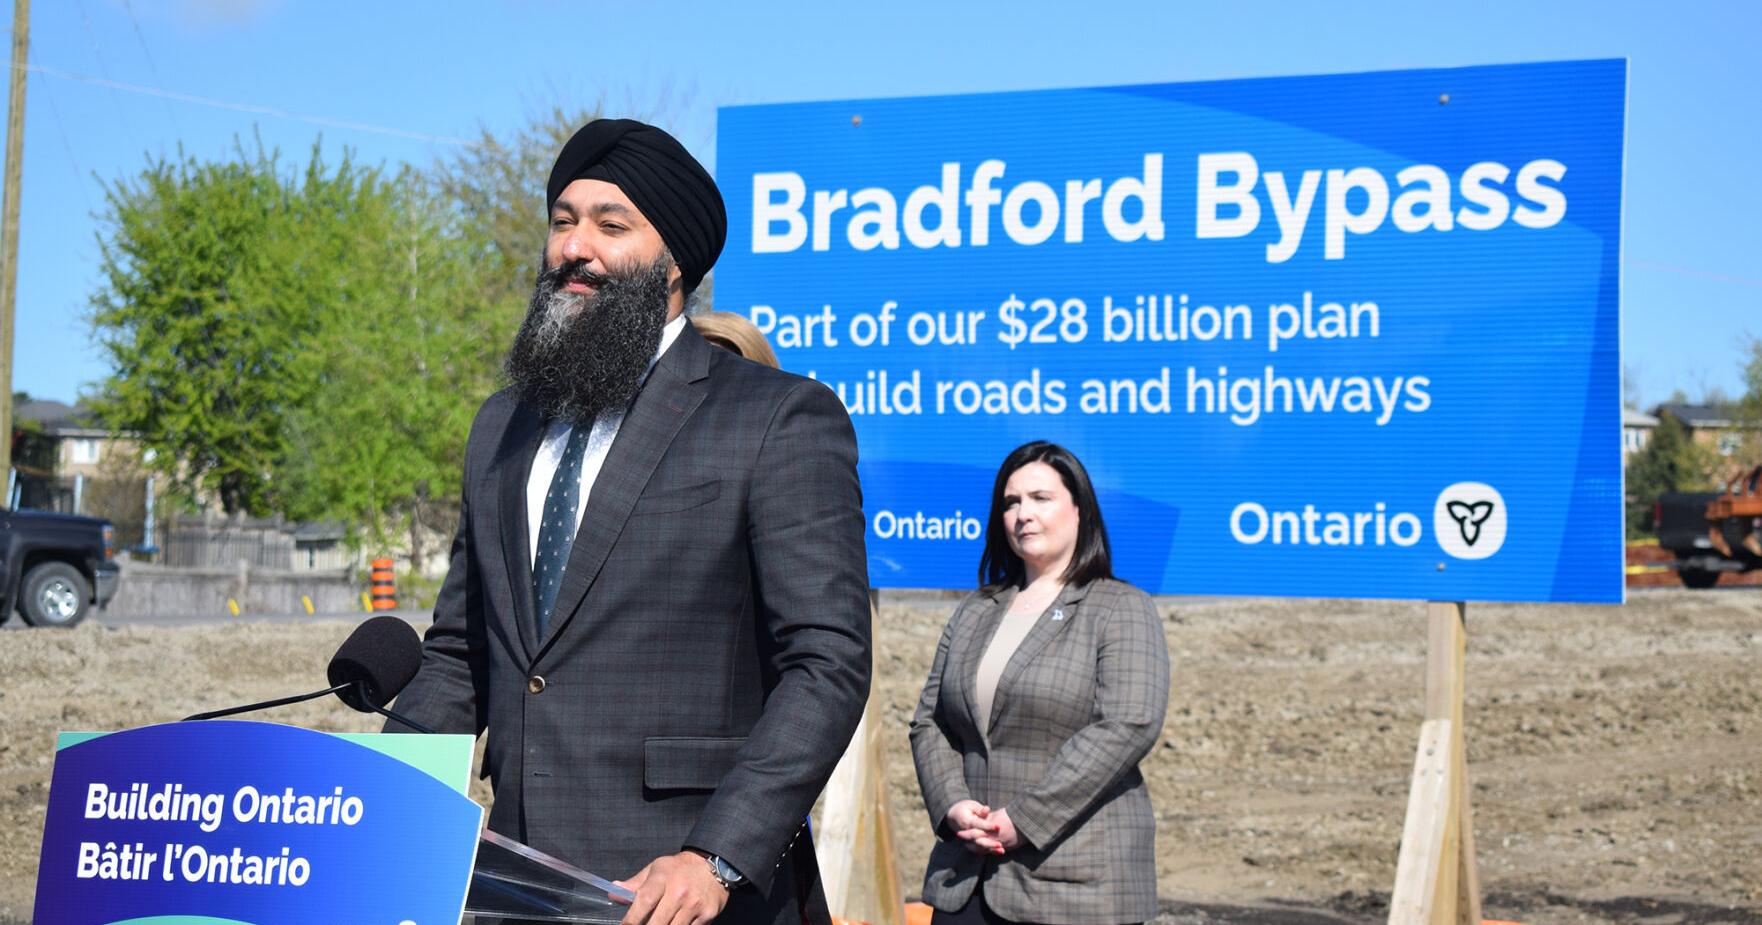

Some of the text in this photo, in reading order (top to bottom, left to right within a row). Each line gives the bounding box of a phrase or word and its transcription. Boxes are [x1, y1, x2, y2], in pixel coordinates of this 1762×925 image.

[751, 151, 1568, 264] Bradford Bypass
[750, 290, 1380, 352] Part of our $28 billion plan
[808, 365, 1432, 427] uild roads and highways
[873, 510, 982, 541] Ontario
[1230, 501, 1423, 547] Ontario
[84, 782, 365, 833] Building Ontario
[76, 841, 312, 888] Bâtir l’Ontario
